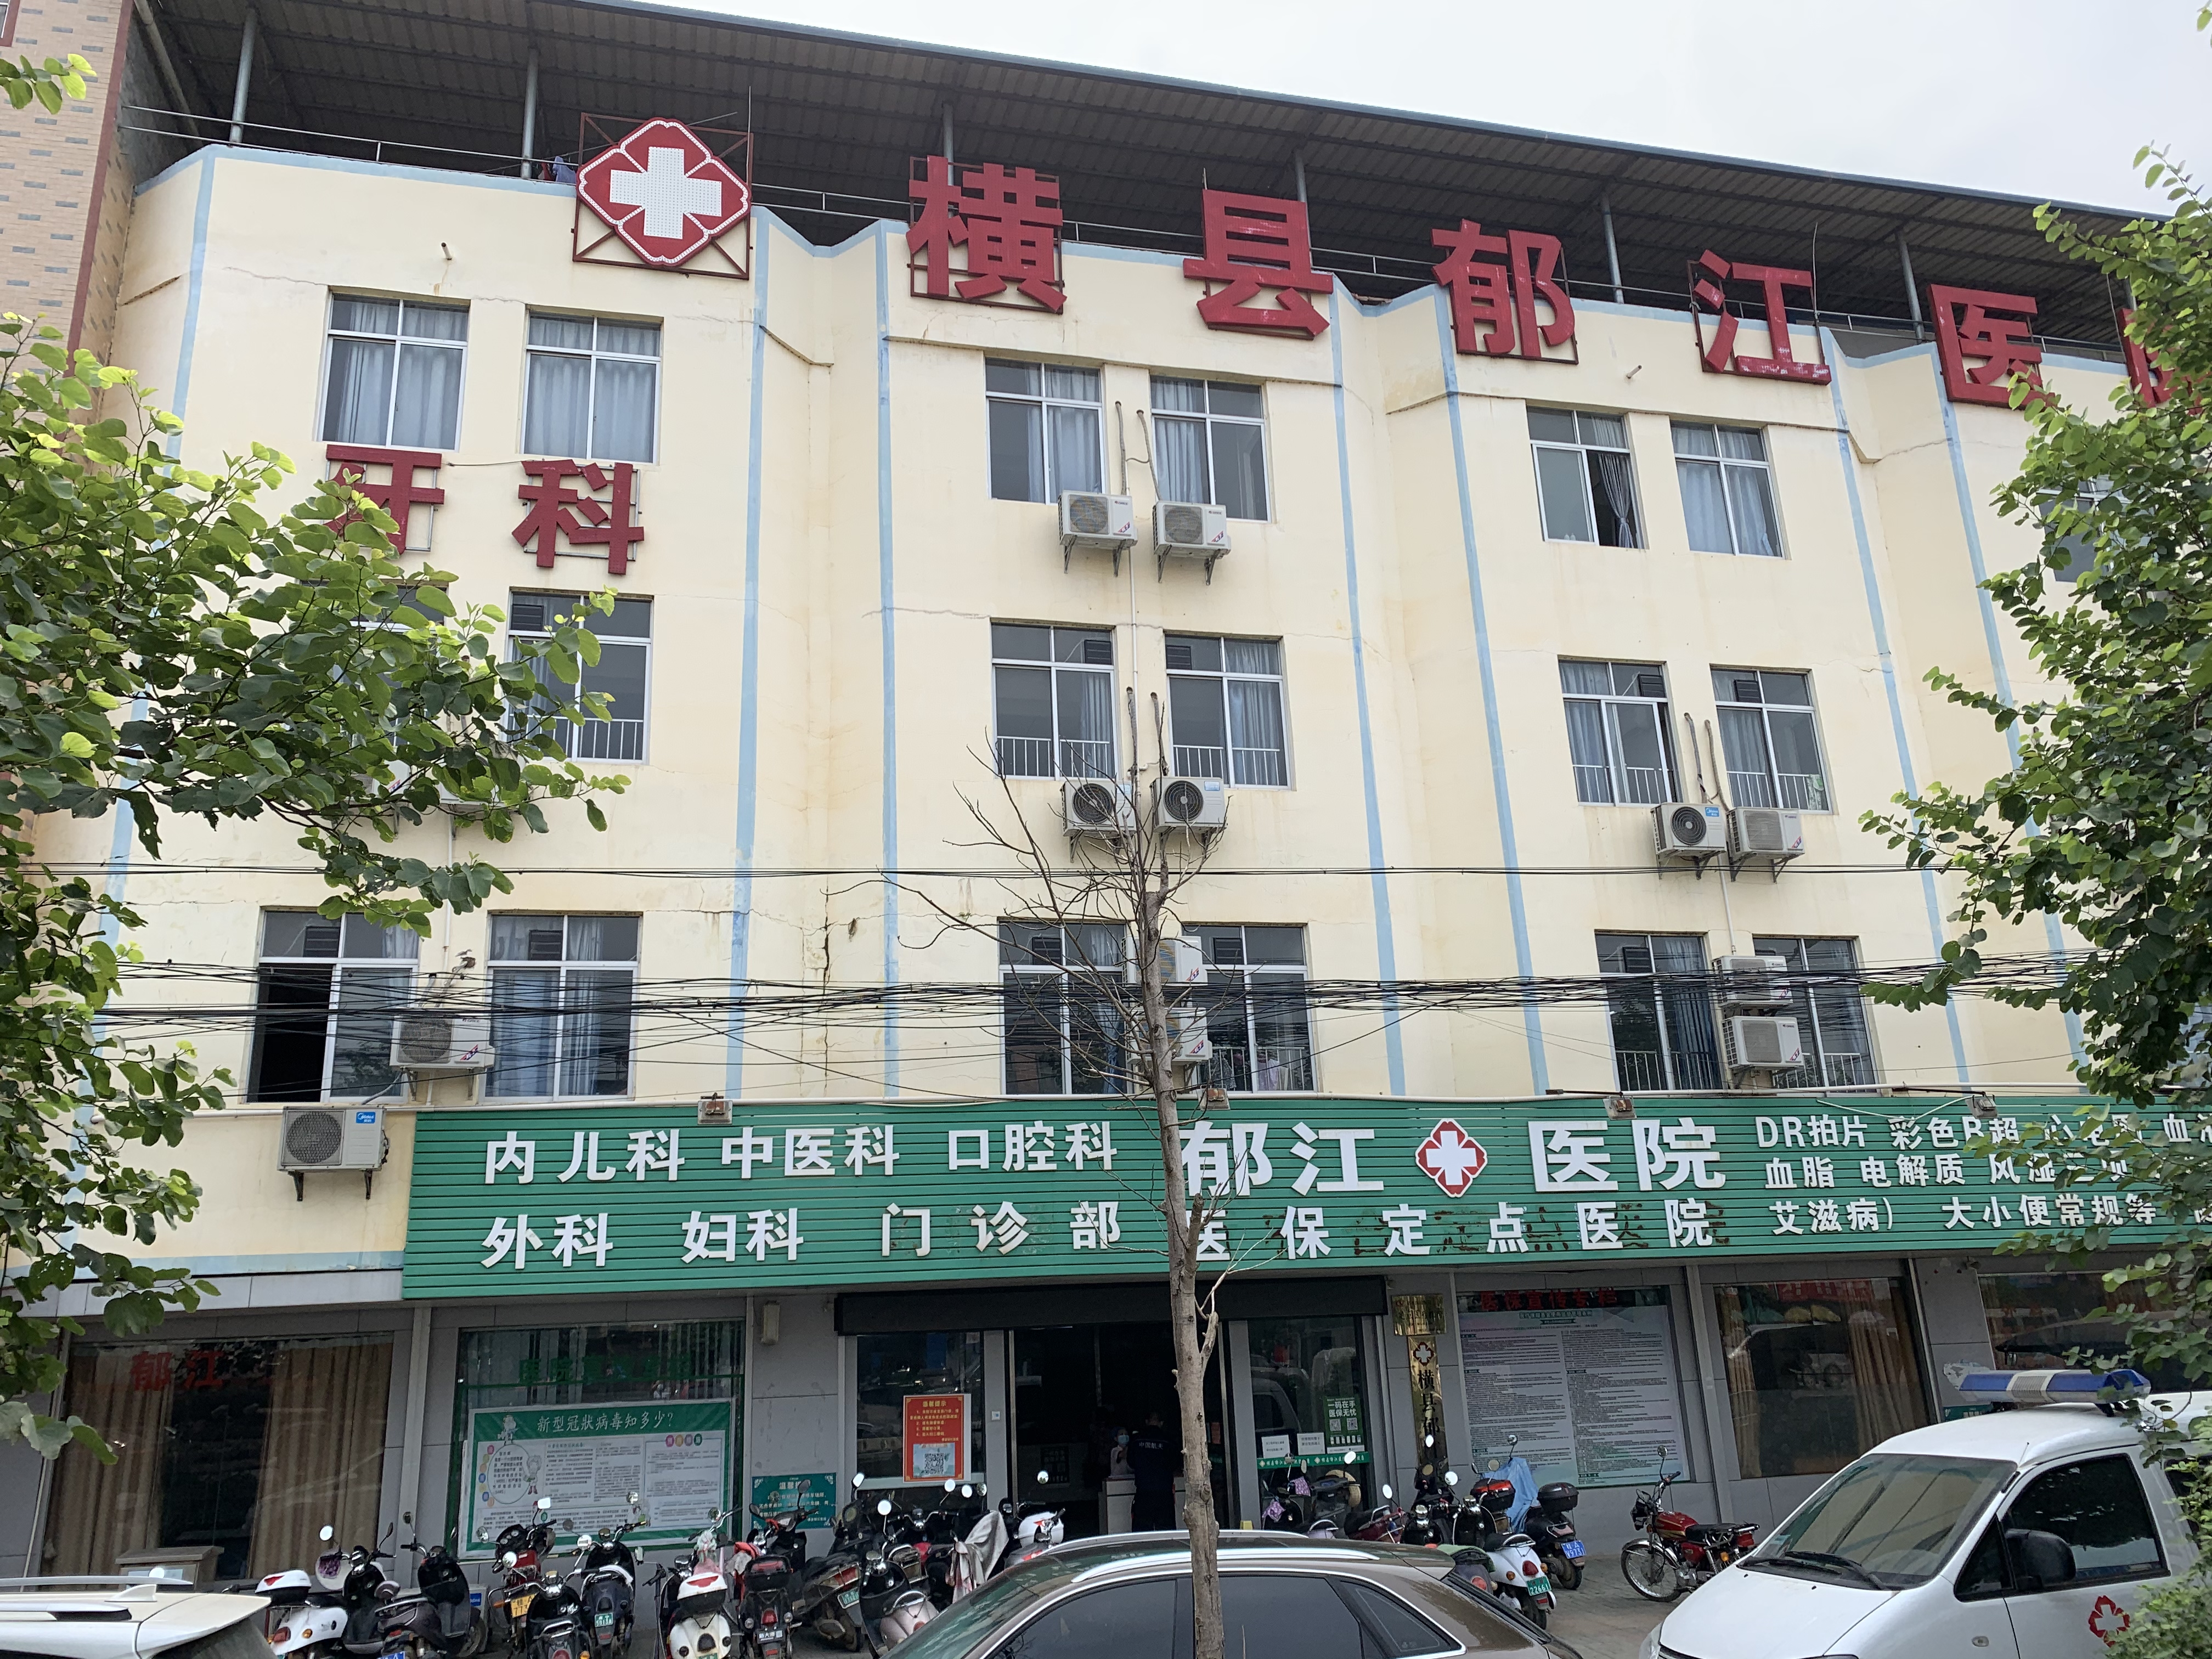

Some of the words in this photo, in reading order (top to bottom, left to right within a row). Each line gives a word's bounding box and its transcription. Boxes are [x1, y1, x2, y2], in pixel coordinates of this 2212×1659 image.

[1756, 1114, 1867, 1148] DR拍片
[484, 1128, 685, 1184] 内儿科
[720, 1125, 900, 1179] 中医科
[947, 1120, 1118, 1172] 口腔科
[1179, 1120, 1384, 1197] 郁江
[1528, 1116, 1726, 1193] 医院
[1765, 1156, 1834, 1189] 血脂
[1860, 1153, 1965, 1188] 电解质
[1941, 1192, 2157, 1230] 大小便常规等
[481, 1212, 613, 1269] 外科
[682, 1207, 804, 1263] 妇科
[882, 1200, 1121, 1256] 门诊部
[130, 1349, 224, 1391] 郁江
[1327, 1400, 1356, 1409] 一码在手
[1329, 1408, 1357, 1418] 医保无忧
[1530, 1584, 1549, 1594] 22661
